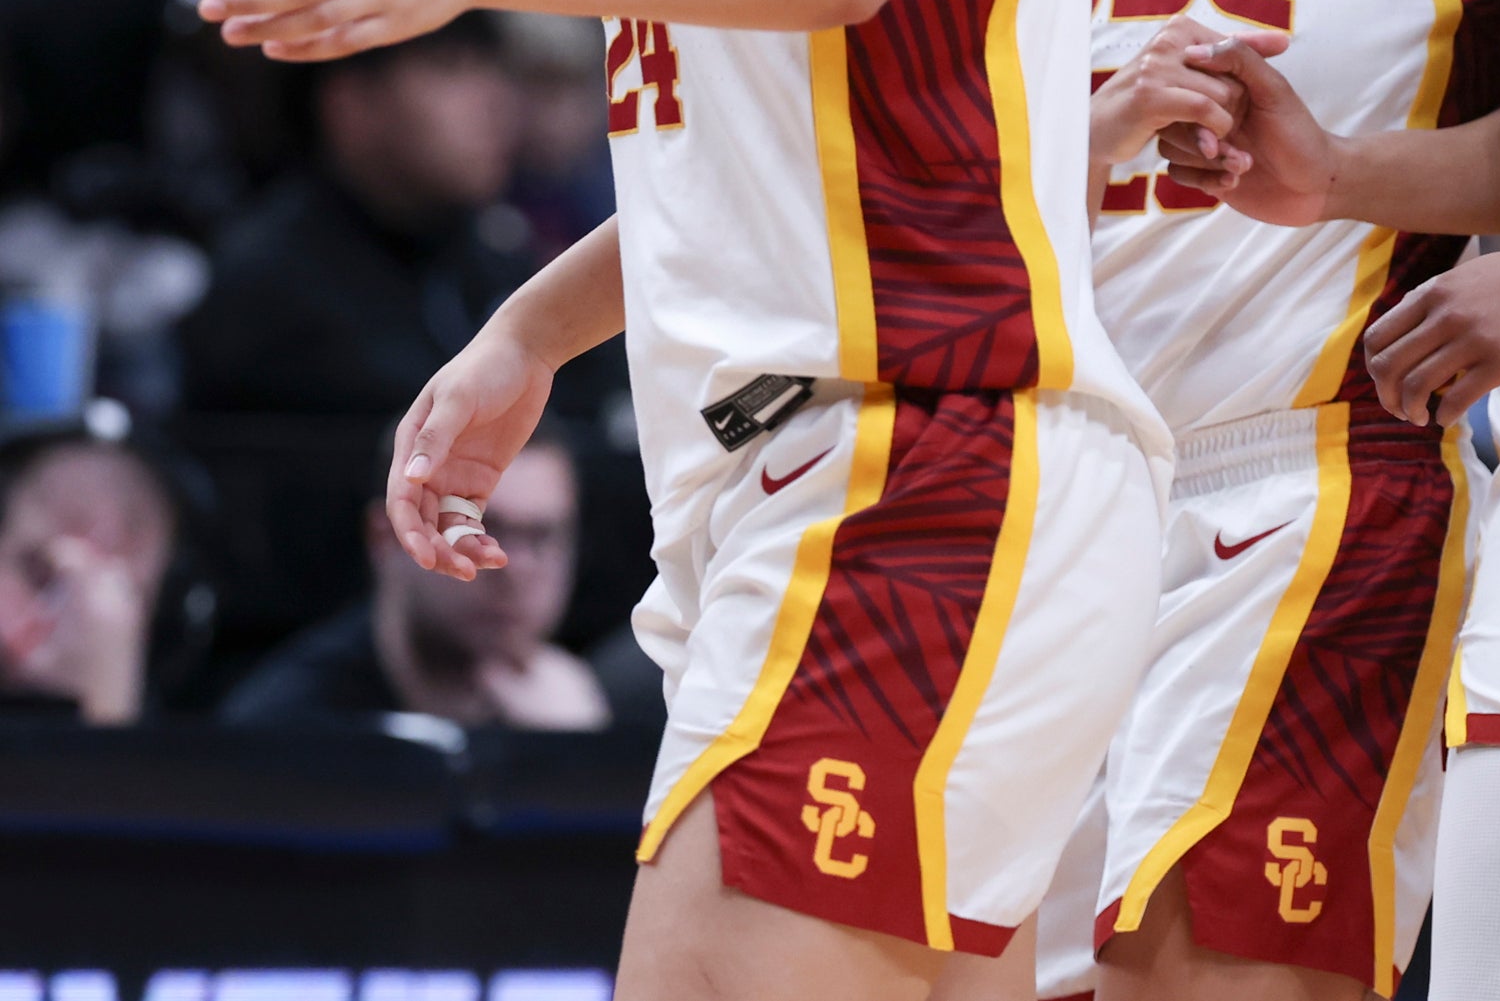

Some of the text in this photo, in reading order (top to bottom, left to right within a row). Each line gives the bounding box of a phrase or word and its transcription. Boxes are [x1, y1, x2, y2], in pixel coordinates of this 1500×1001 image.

[604, 17, 685, 139] 24
[801, 757, 876, 880] SC
[1264, 816, 1328, 924] SC
